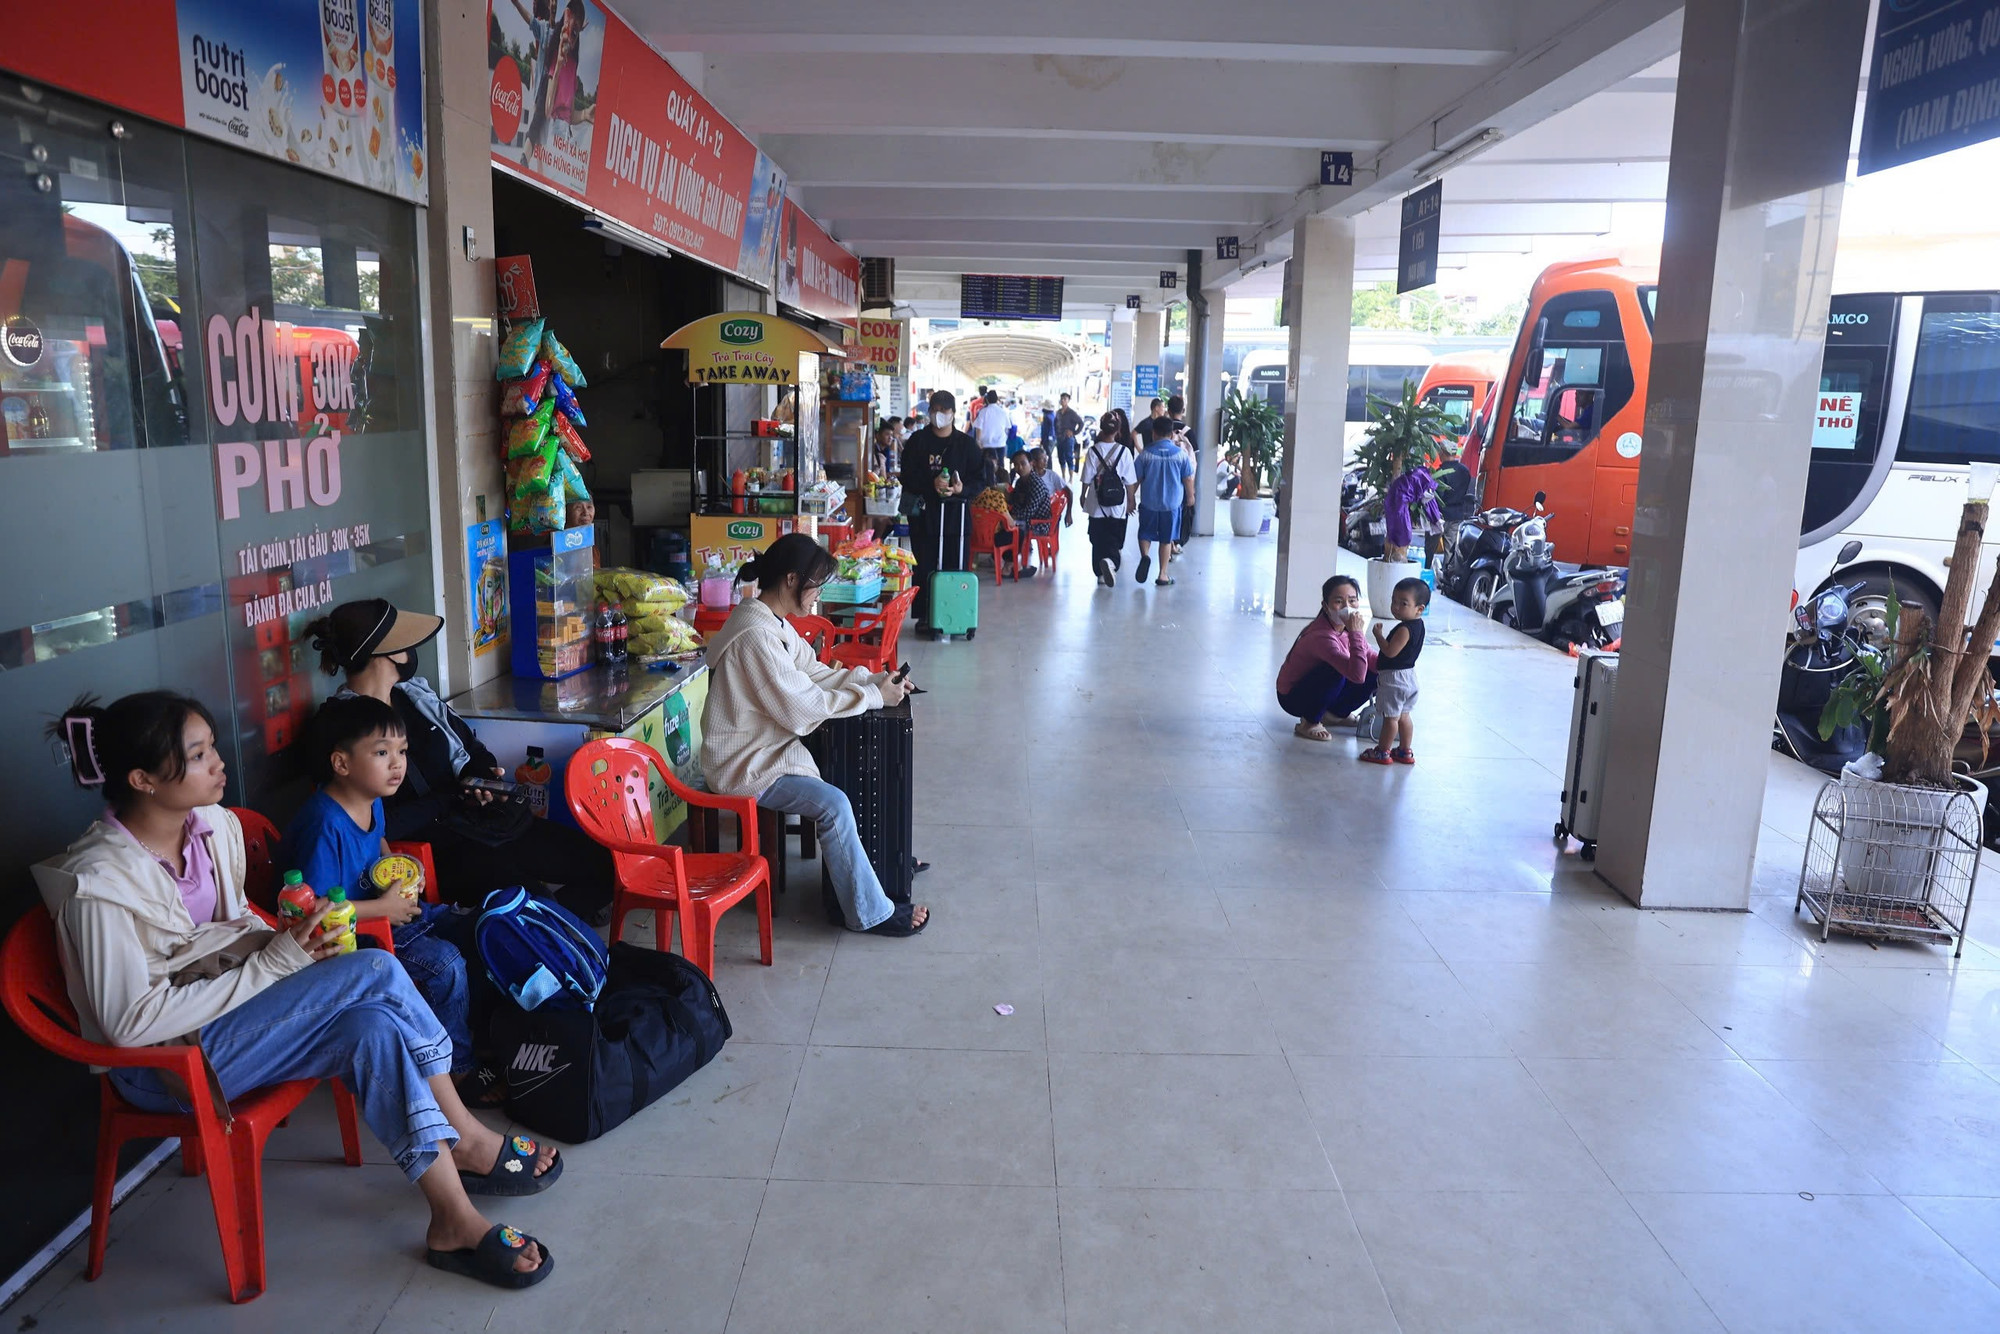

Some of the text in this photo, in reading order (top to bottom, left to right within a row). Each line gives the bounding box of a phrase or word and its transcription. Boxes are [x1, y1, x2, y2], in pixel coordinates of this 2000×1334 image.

[323, 1, 355, 33] boost
[193, 34, 245, 78] nutri
[194, 57, 249, 111] boost
[1896, 94, 1949, 150] (NAM
[1323, 154, 1333, 162] A1
[605, 113, 743, 241] DỊCH VỤ ĂN UỐNG GIẢI KHÁT
[1327, 164, 1349, 182] 14
[1220, 245, 1237, 258] 15
[1163, 277, 1175, 287] 16
[1129, 299, 1139, 308] 17
[724, 323, 758, 339] Cozy
[861, 321, 901, 339] CƠM
[712, 350, 774, 367] Trà Trái Cây
[871, 341, 897, 363] HỞ
[208, 306, 356, 427] CƠM 30K
[695, 365, 791, 382] TAKE AWAY
[218, 413, 342, 521] PHỞ
[1908, 474, 1959, 483] FELIX
[730, 524, 760, 539] Cozy
[239, 542, 258, 575] TÁI
[245, 594, 276, 628] BÁNH
[278, 590, 293, 617] ĐA
[415, 1048, 440, 1063] DIOR
[511, 1043, 559, 1073] NIKE
[399, 1152, 417, 1170] IOR
